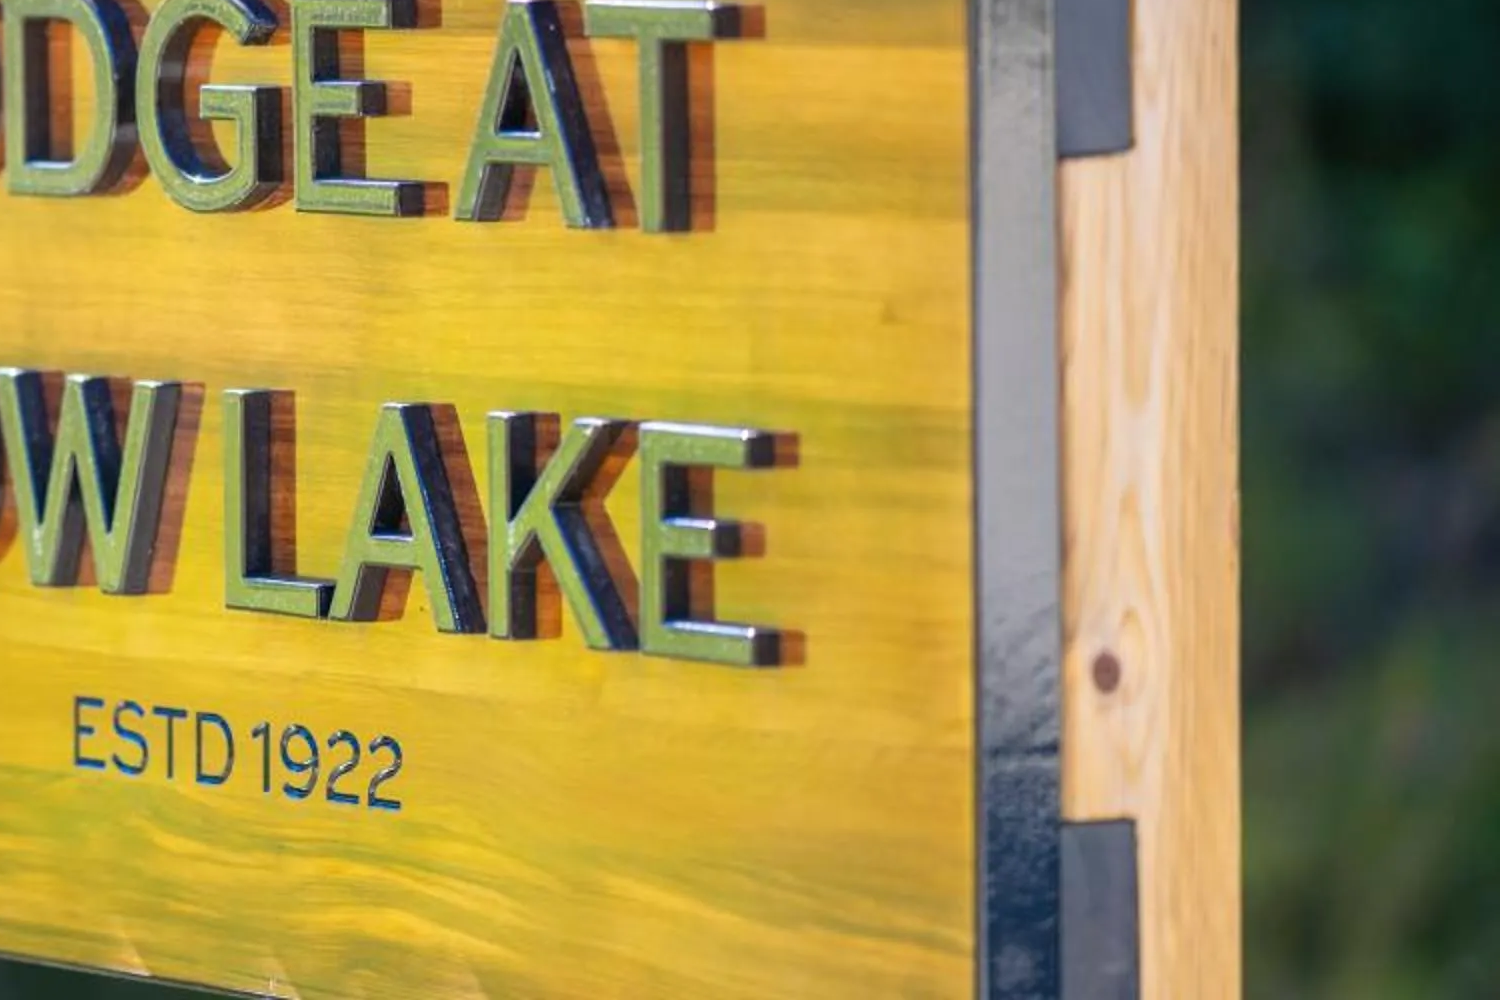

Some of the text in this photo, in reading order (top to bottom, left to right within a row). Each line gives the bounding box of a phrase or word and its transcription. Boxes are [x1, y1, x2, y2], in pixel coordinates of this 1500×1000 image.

[223, 387, 784, 667] LAKE
[74, 695, 404, 810] ESTD 1922
